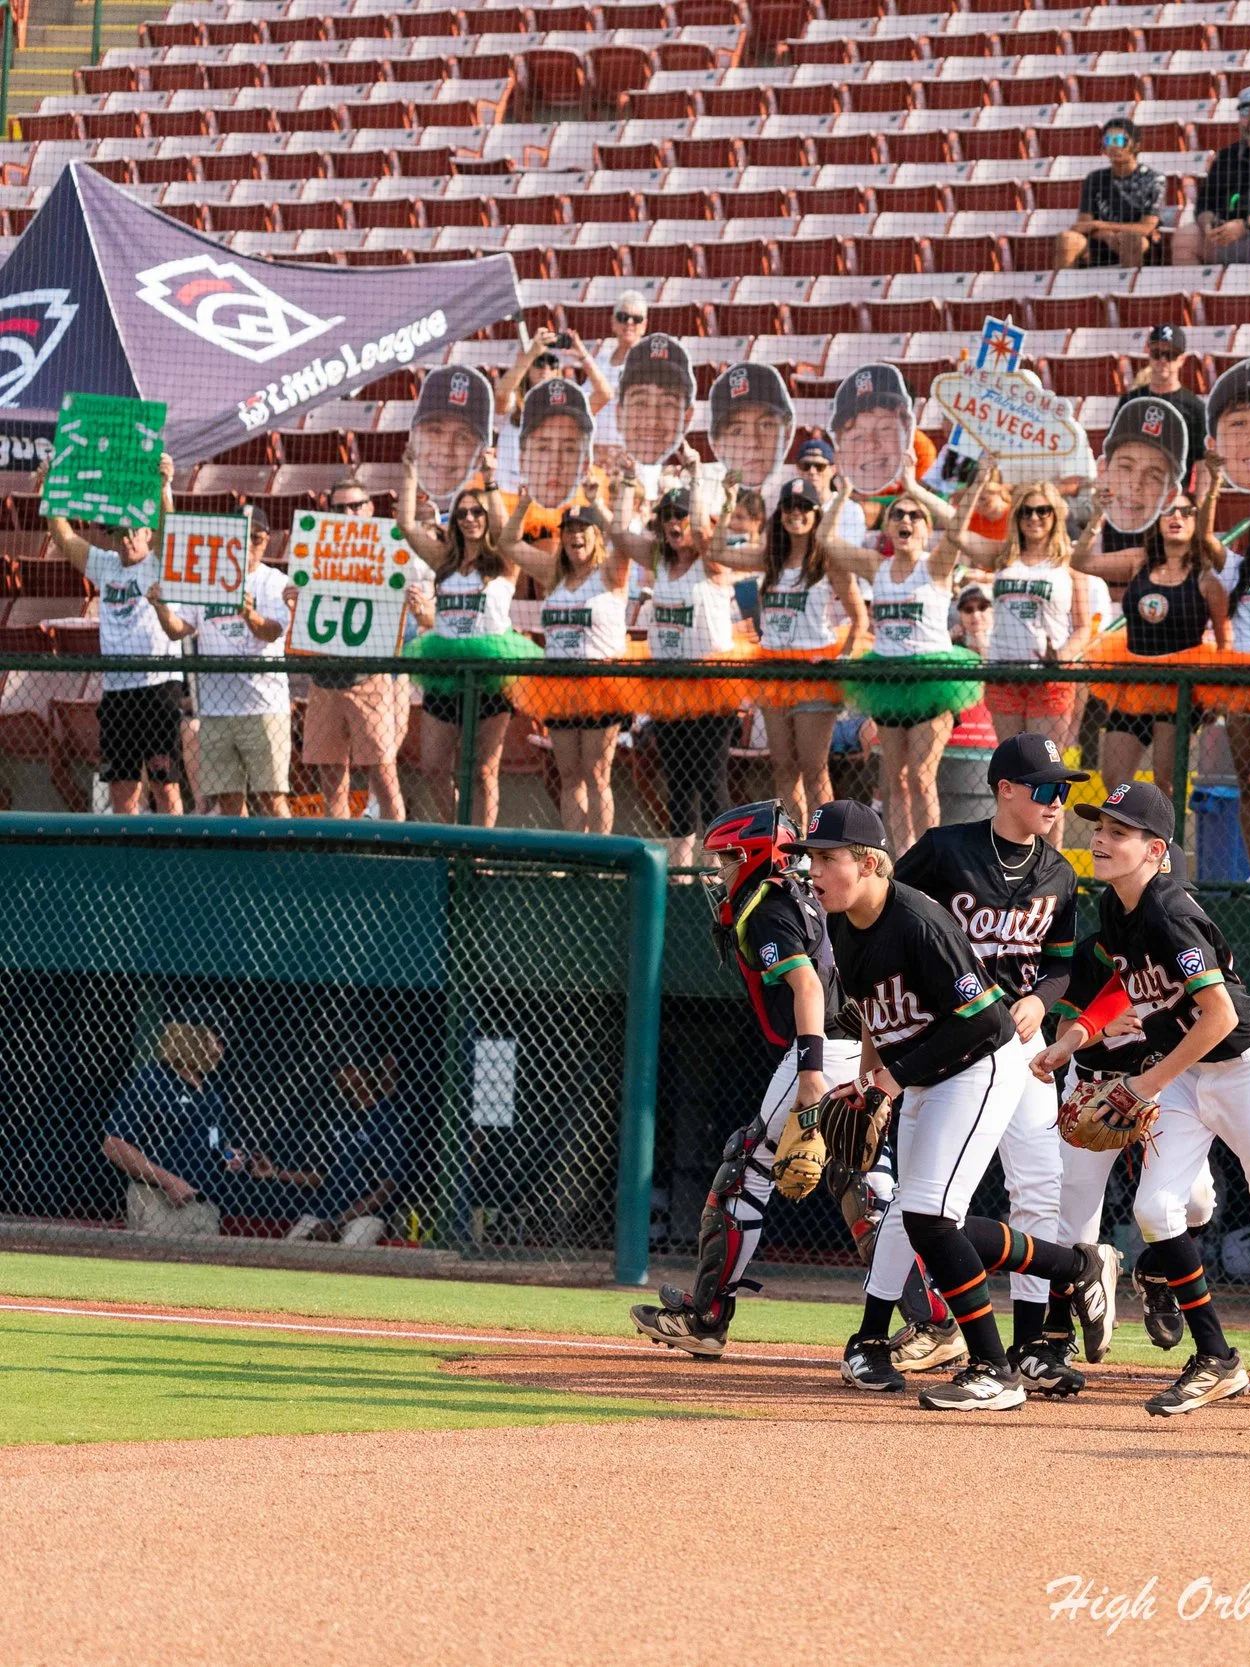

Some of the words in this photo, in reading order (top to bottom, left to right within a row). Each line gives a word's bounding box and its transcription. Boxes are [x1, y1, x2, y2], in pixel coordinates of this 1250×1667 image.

[964, 365, 1065, 417] WELCOME
[953, 392, 991, 420] LAS
[996, 409, 1060, 450] VEGAS
[163, 533, 242, 592] LETS
[312, 560, 384, 585] SIBLINGS
[308, 595, 373, 646] GO
[850, 973, 936, 1033] uth
